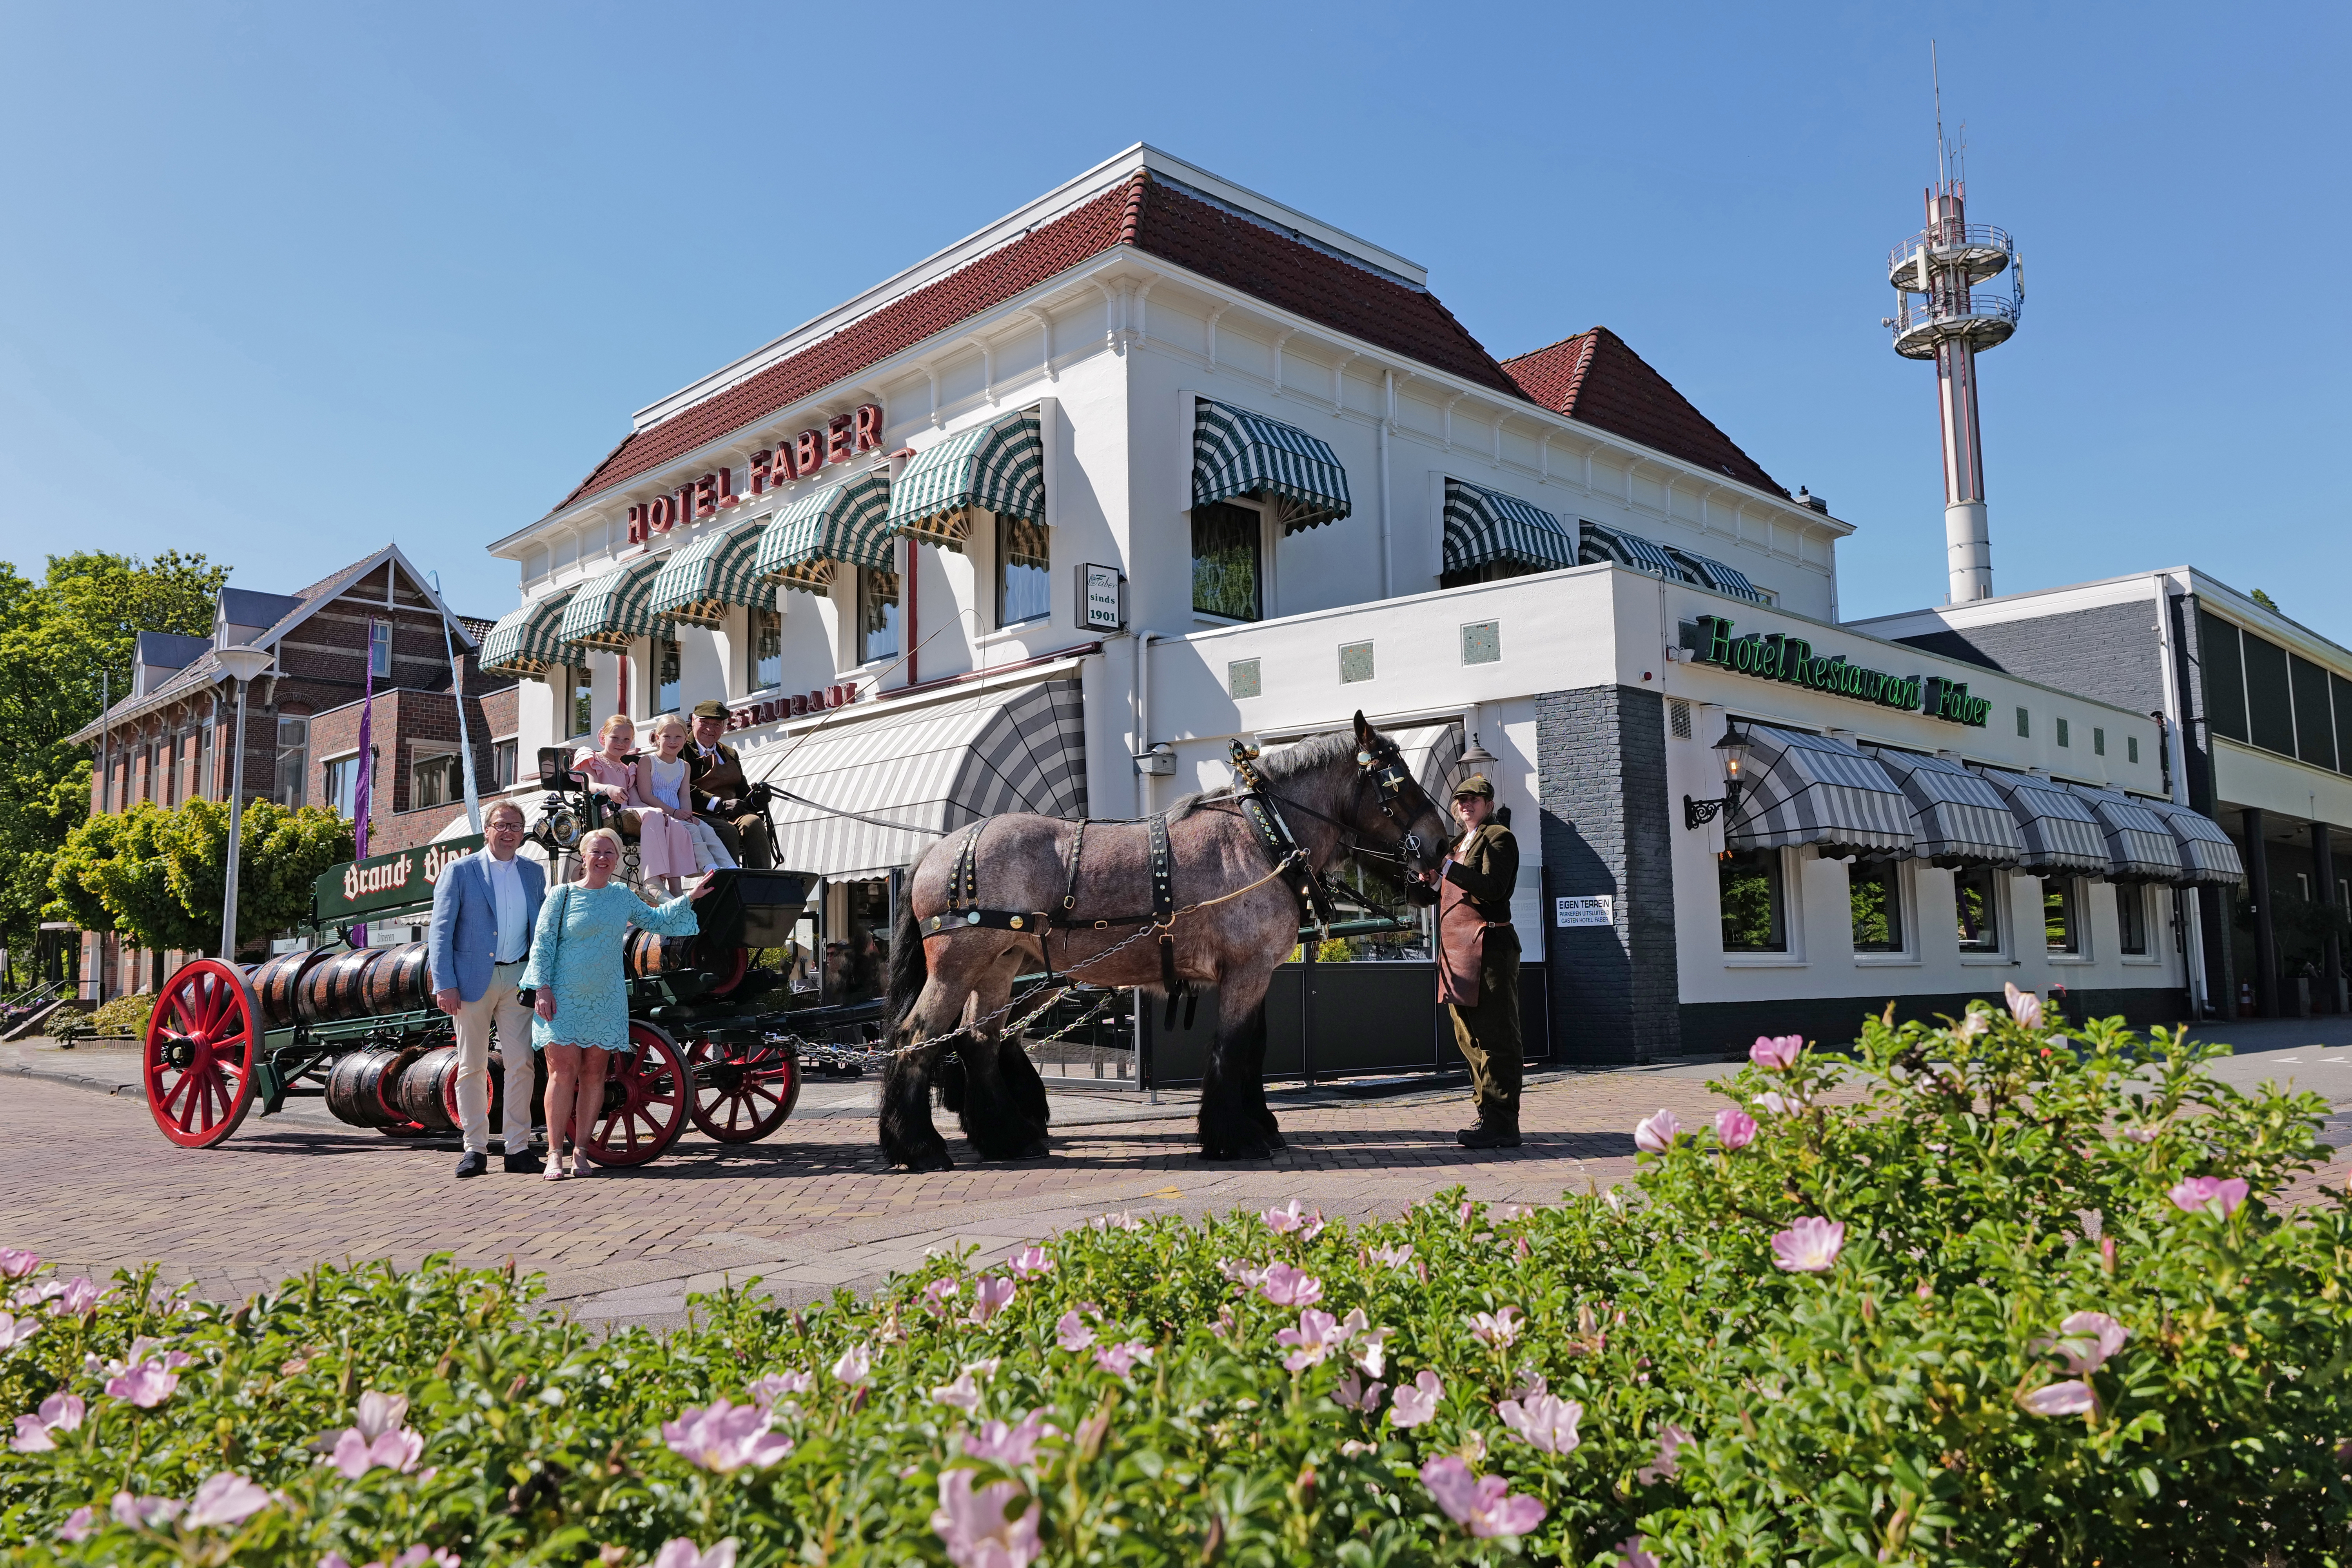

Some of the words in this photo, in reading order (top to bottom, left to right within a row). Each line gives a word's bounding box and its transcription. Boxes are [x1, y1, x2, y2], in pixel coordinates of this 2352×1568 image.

[627, 467, 739, 545] HOTEL
[750, 403, 883, 496] FABER
[1088, 573, 1118, 589] Faber
[1090, 593, 1115, 604] sinds
[1090, 610, 1116, 622] 1901
[1697, 615, 1786, 679] Hotel
[1786, 638, 1922, 710] Restaurant
[1928, 677, 1993, 727] Faber
[1559, 900, 1579, 909] EIGEN
[1581, 899, 1609, 908] TERREIN
[377, 933, 394, 942] Dineren
[284, 942, 297, 950] Lunchen
